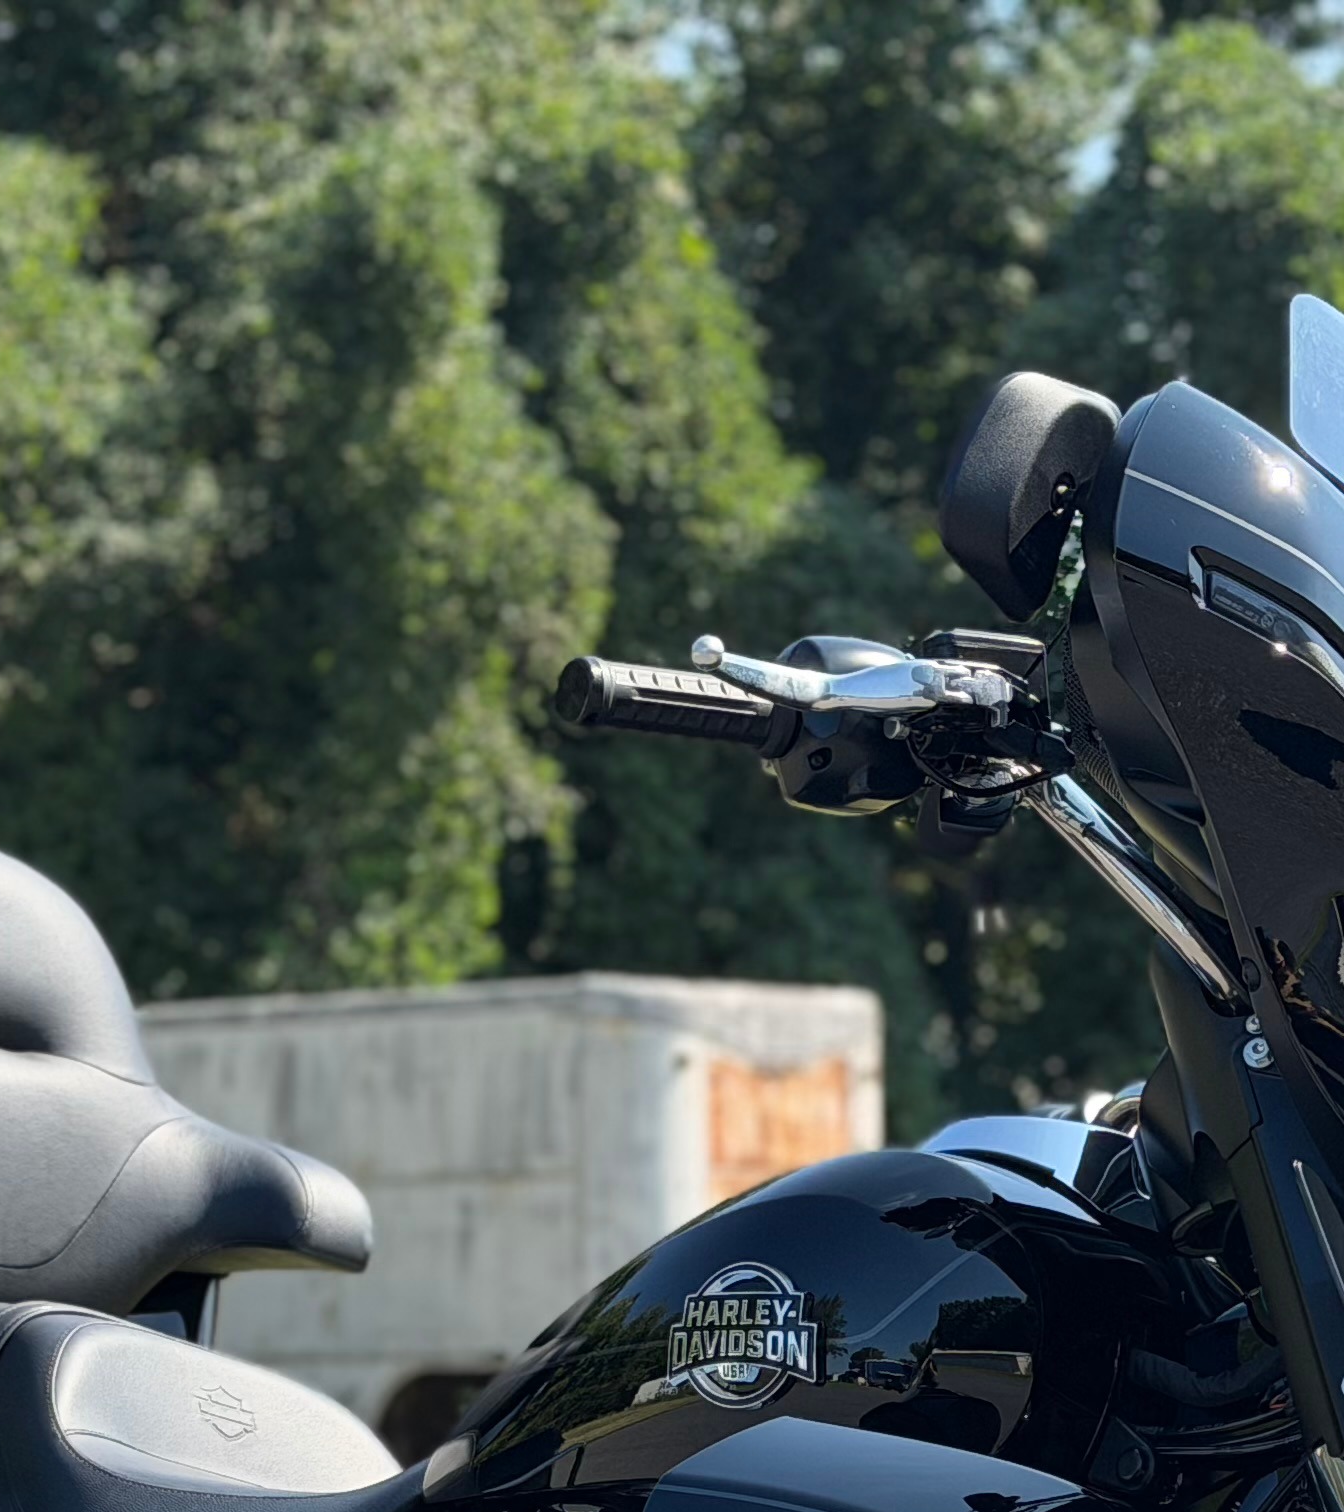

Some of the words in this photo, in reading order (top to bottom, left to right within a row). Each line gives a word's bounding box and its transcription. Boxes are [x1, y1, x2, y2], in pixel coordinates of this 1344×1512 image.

[686, 1298, 797, 1328] HARLEY-
[671, 1329, 809, 1372] DAVIDSON
[722, 1363, 747, 1379] USA
